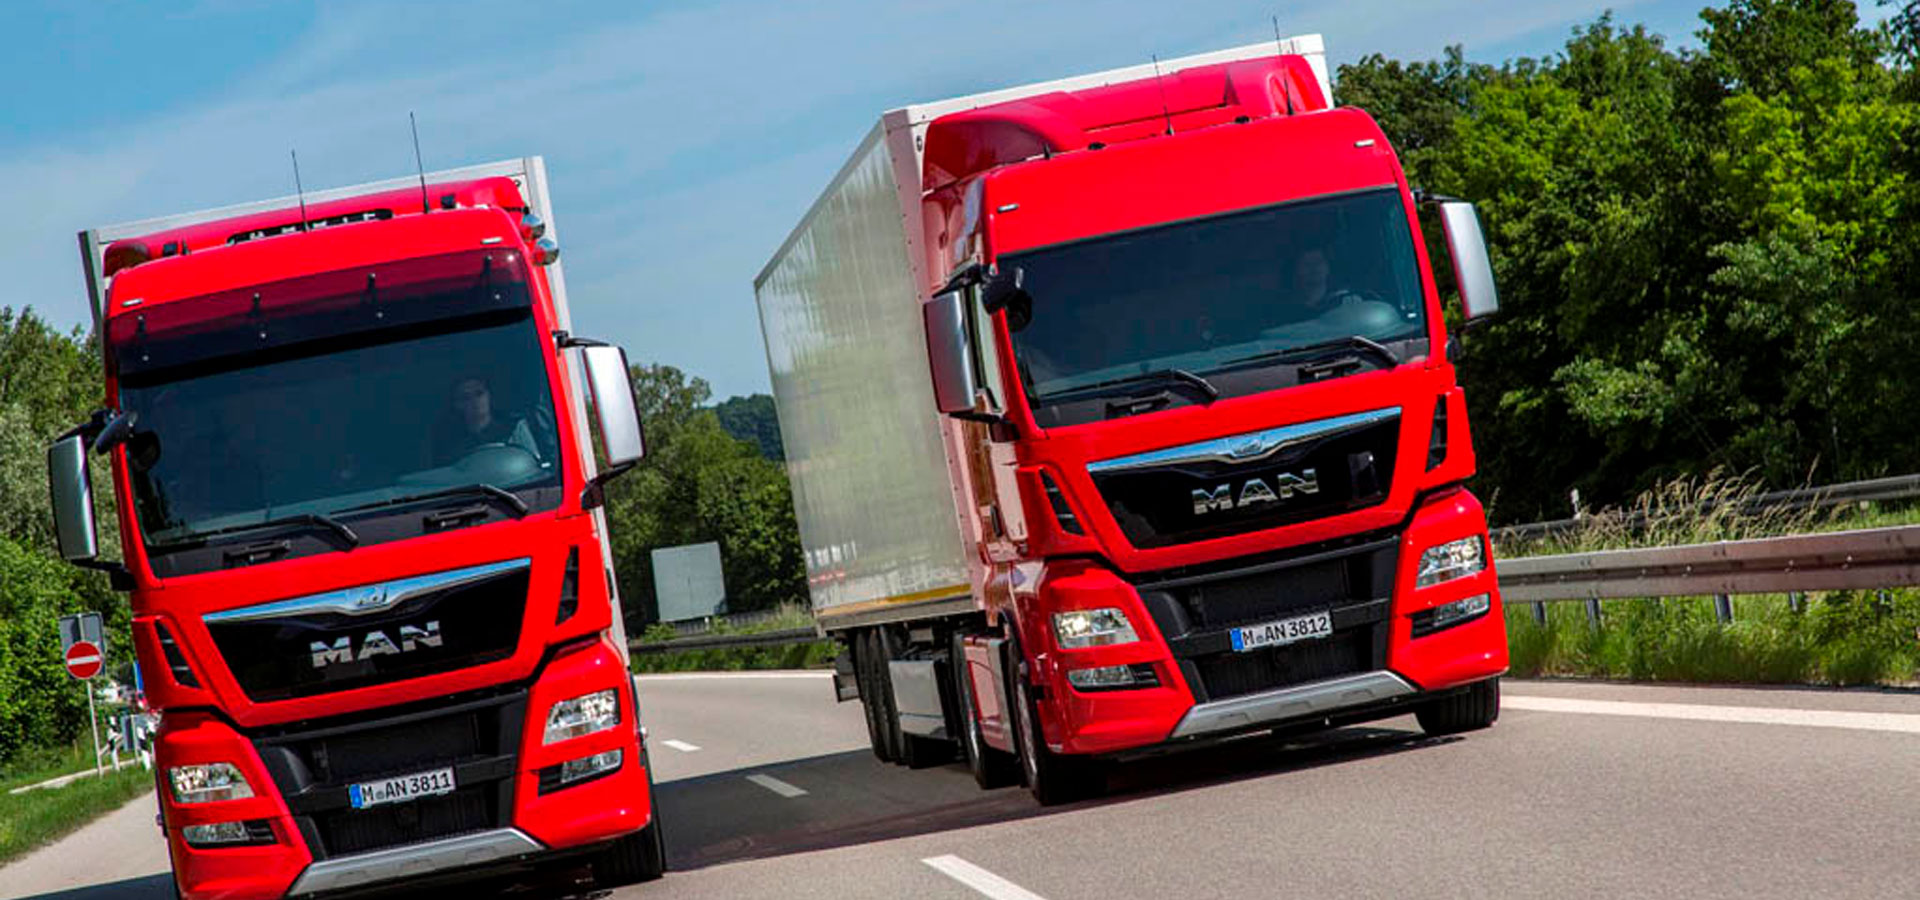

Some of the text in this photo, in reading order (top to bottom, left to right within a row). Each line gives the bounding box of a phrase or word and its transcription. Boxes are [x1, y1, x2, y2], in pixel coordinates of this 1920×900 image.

[1192, 468, 1319, 515] MAN
[1288, 616, 1329, 637] 3812
[310, 620, 443, 668] MAN
[410, 772, 451, 794] 3811
